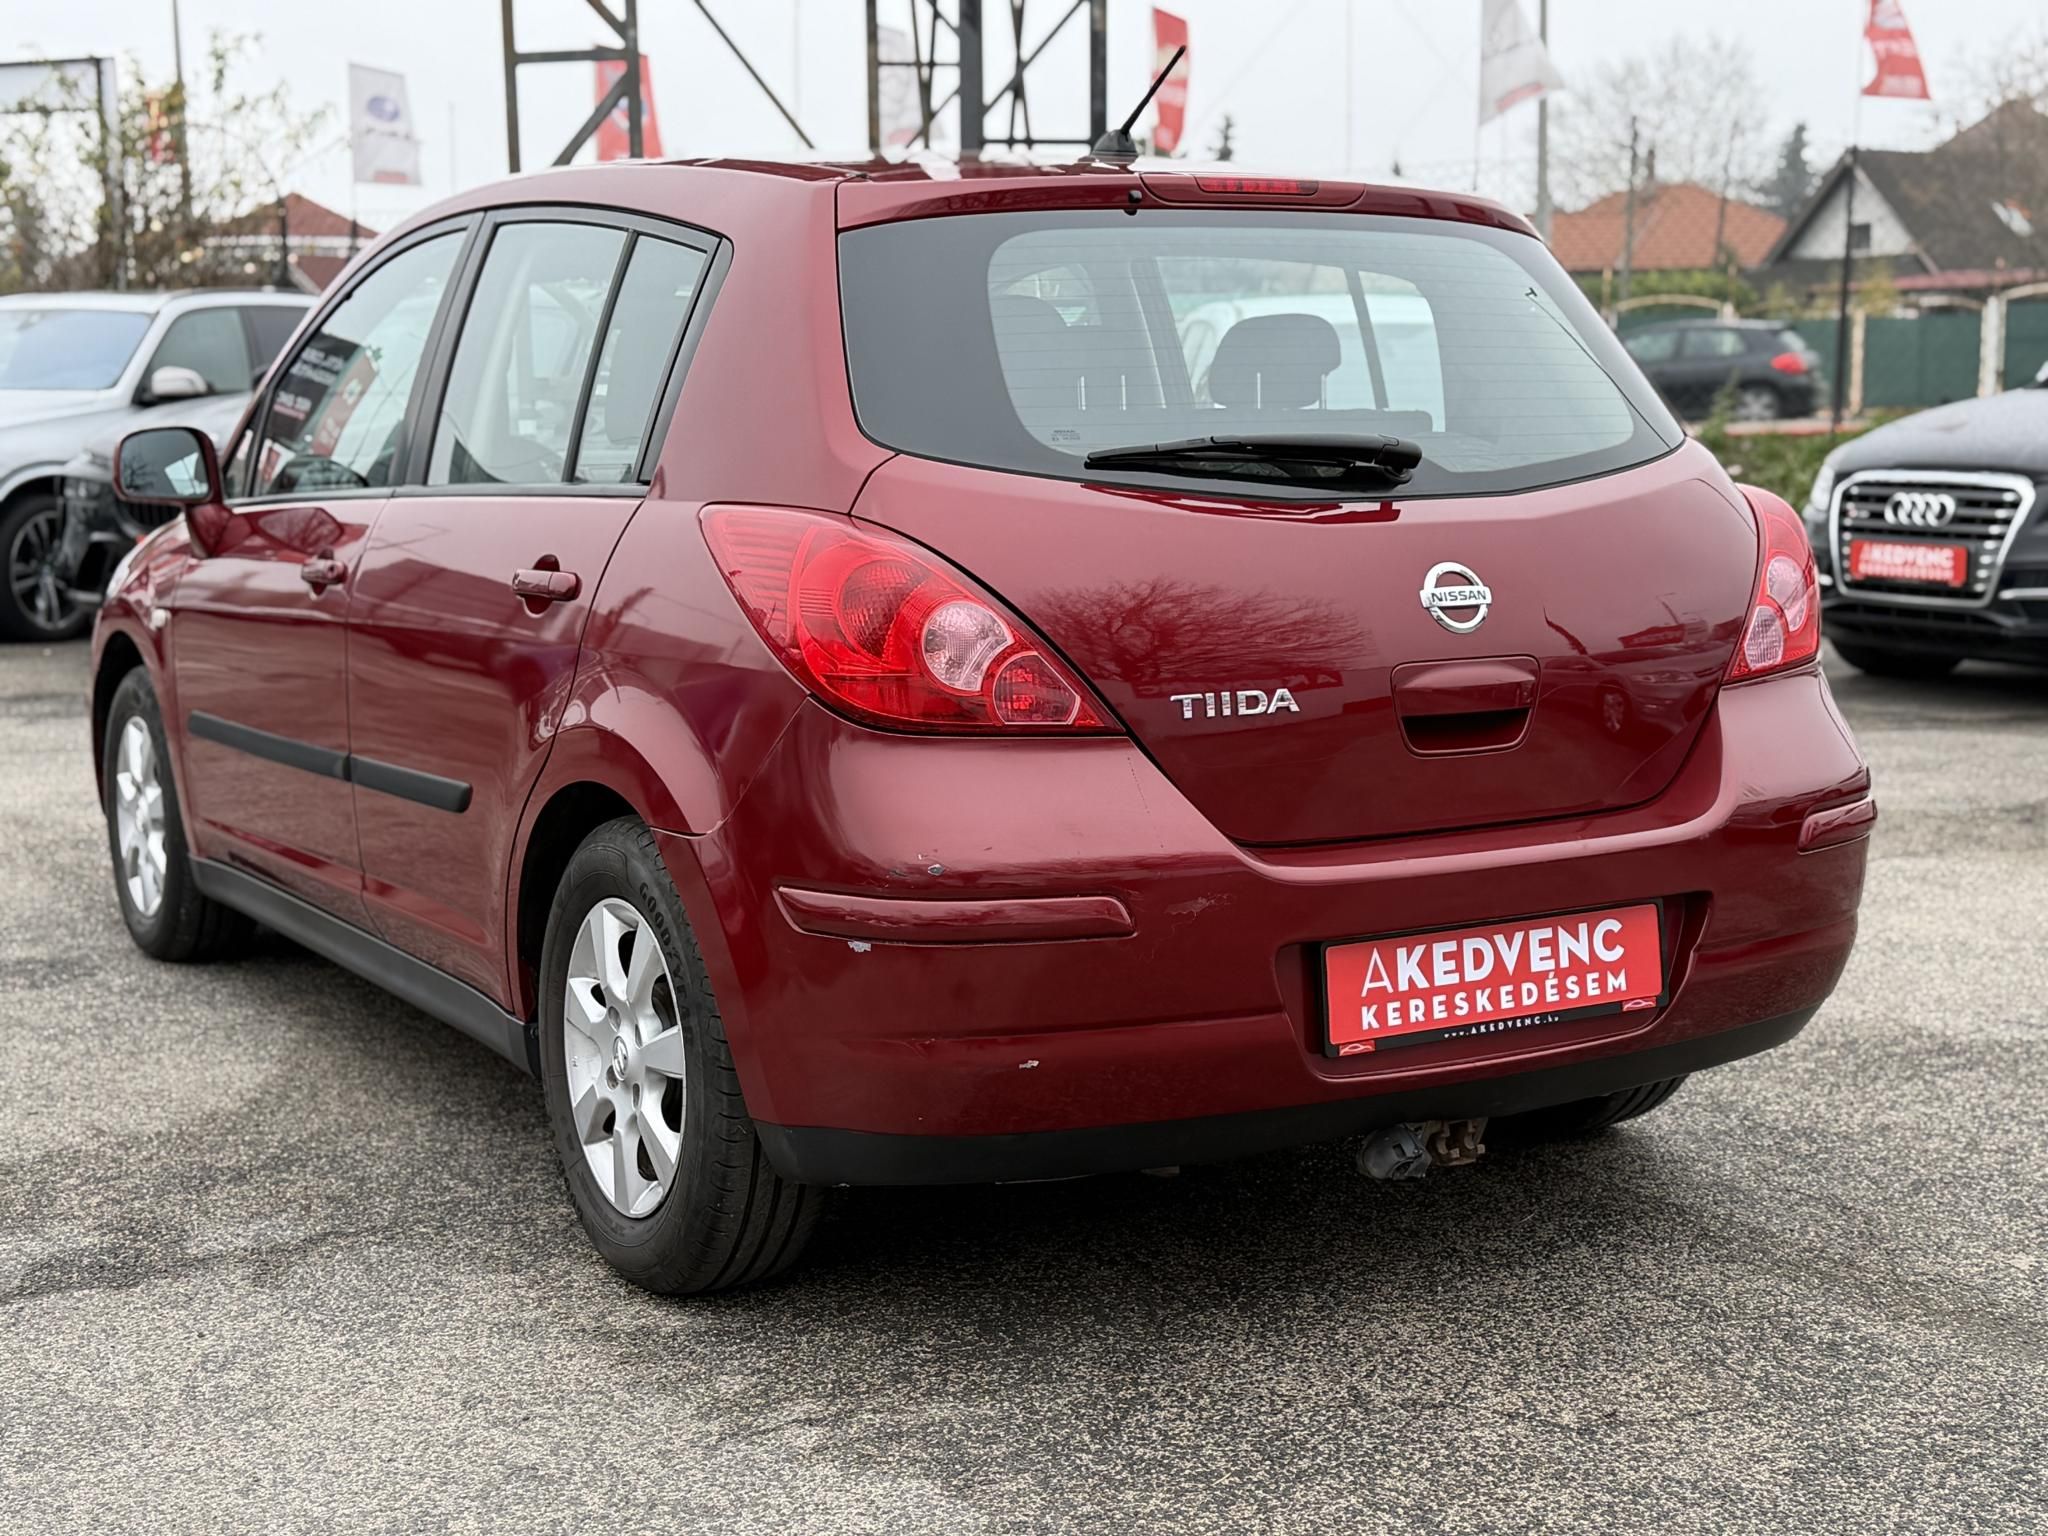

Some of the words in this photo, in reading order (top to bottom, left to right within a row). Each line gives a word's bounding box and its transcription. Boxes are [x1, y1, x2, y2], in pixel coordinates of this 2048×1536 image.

[1431, 590, 1487, 603] NISSAN
[1170, 688, 1300, 719] TIIDA
[1361, 918, 1625, 997] AKEDVENC
[1361, 968, 1627, 1031] KERESKEDÉSEM
